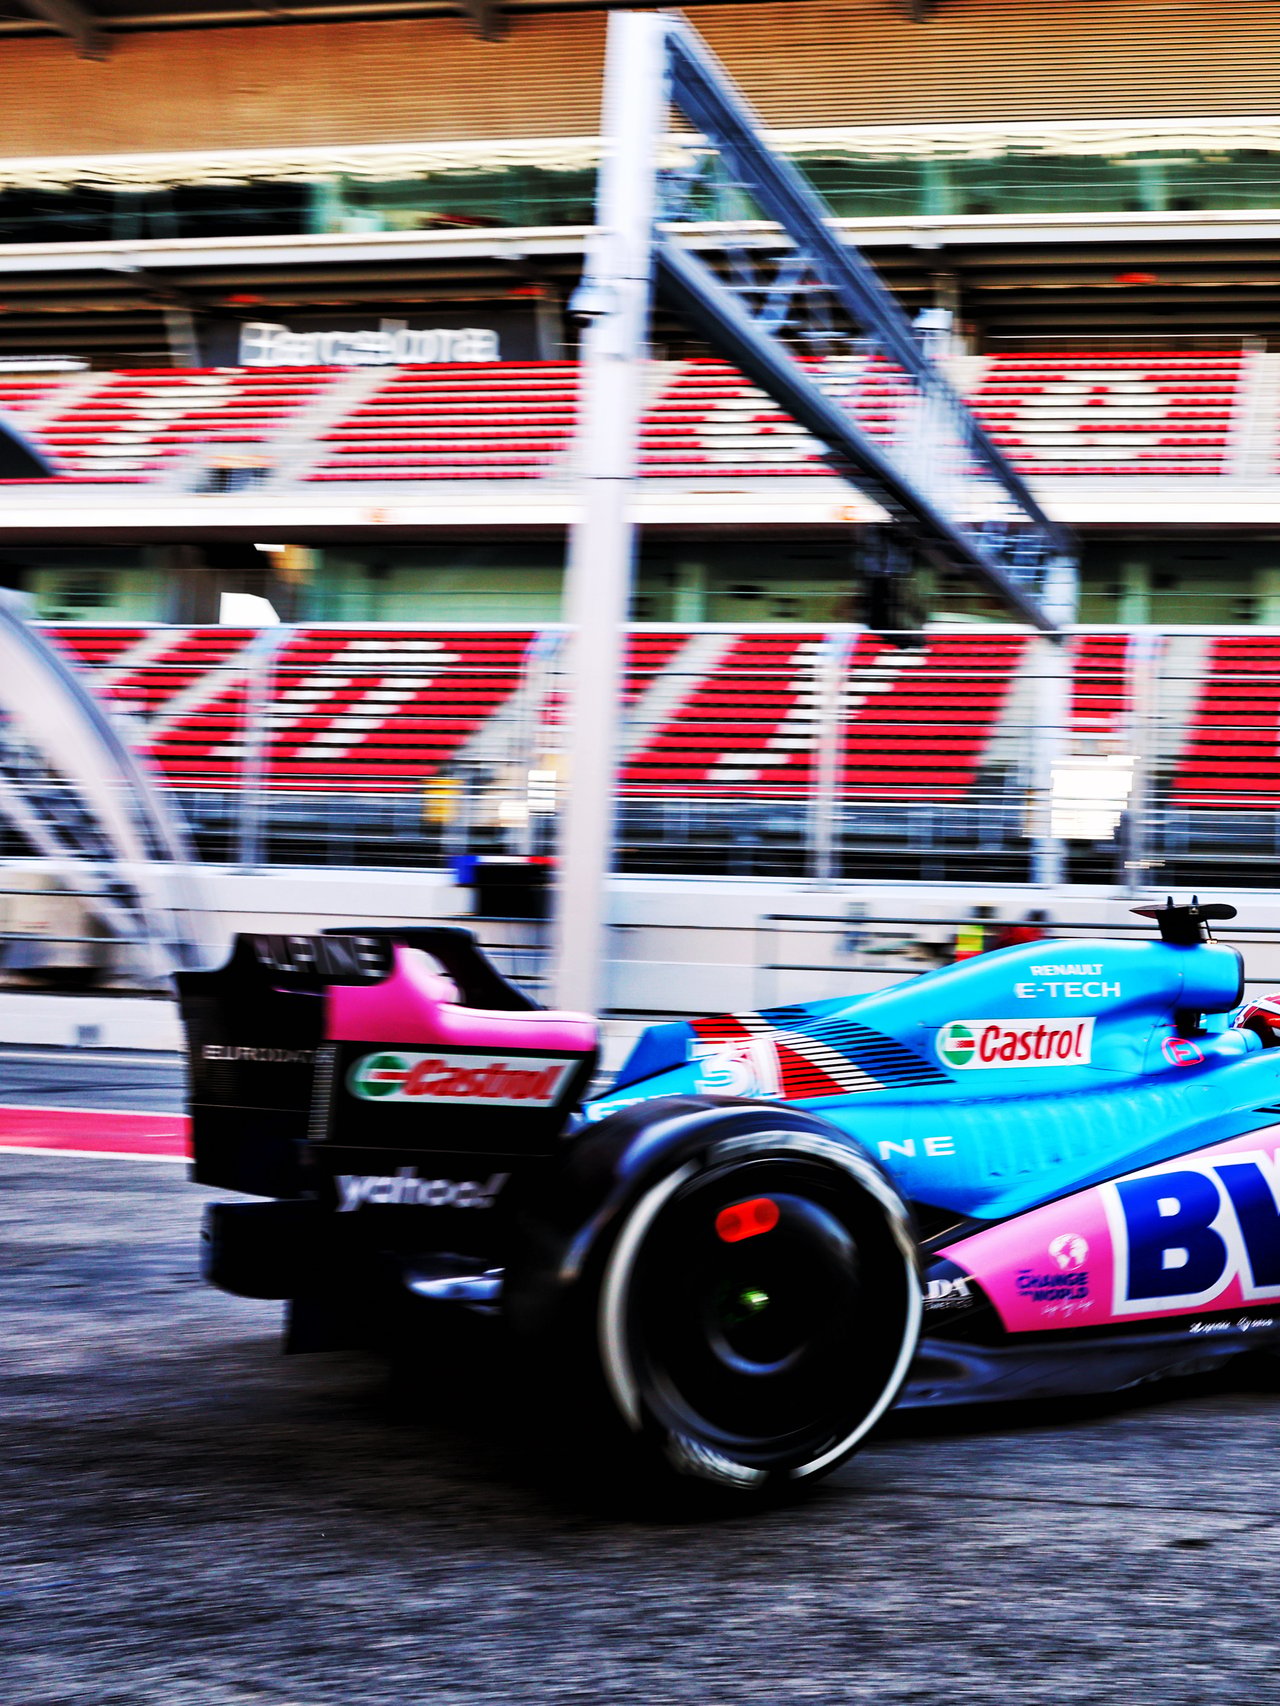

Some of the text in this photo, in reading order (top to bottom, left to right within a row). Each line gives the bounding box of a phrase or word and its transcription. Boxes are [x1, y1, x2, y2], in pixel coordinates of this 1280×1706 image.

[239, 320, 501, 368] Barcelona
[1014, 982, 1121, 998] E-TECH
[1029, 964, 1104, 976] RENAULT
[980, 1023, 1085, 1063] Castrol
[403, 1058, 564, 1101] Castrol
[334, 1166, 511, 1212] yahoo!
